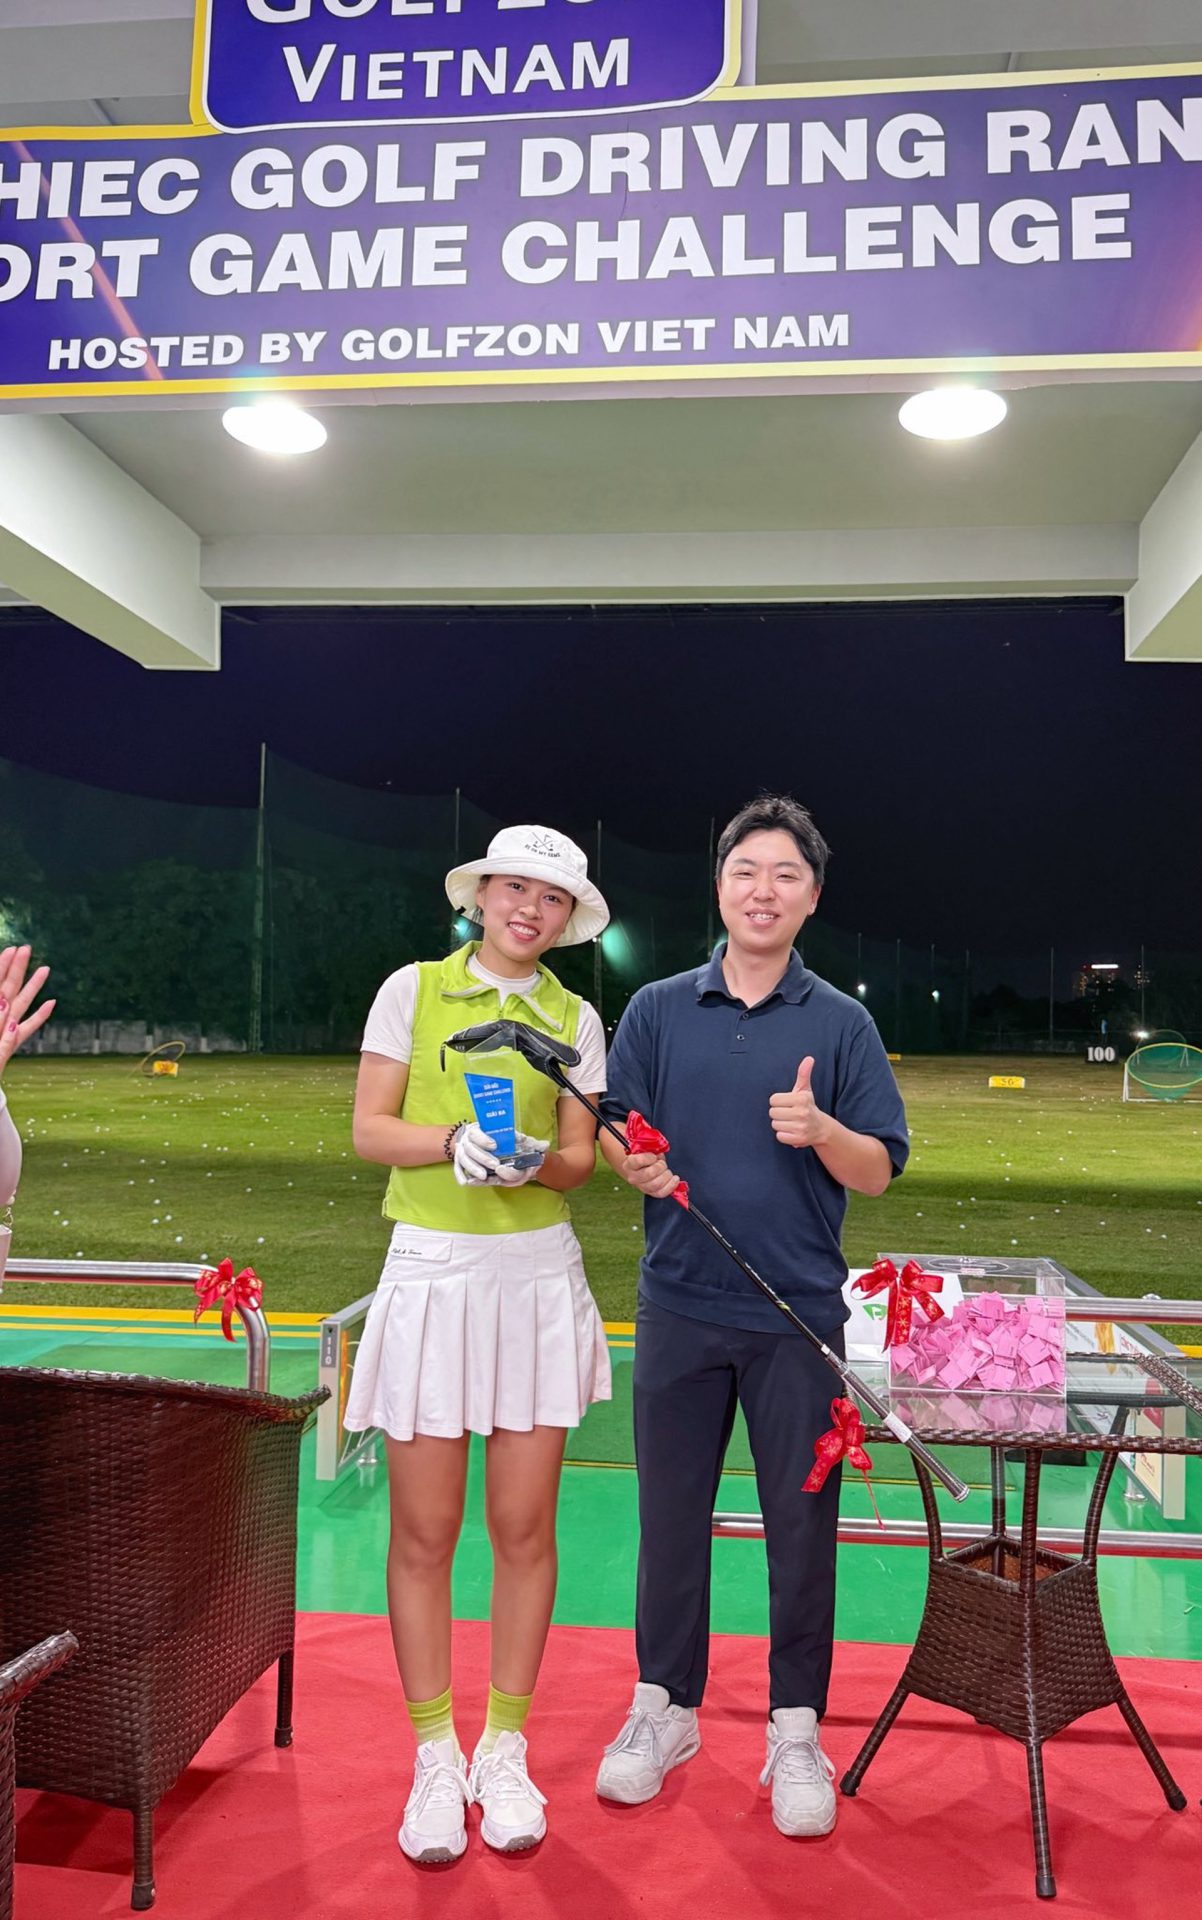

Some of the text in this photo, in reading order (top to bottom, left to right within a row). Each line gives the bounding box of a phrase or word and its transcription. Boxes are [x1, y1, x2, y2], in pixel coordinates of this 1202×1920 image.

[283, 38, 629, 102] VIETNAM
[230, 140, 486, 210] GOLF
[520, 113, 946, 197] DRIVING
[987, 97, 1202, 174] RAN
[189, 225, 468, 296] GAME
[501, 193, 1132, 285] CHALLENGE
[48, 313, 849, 370] HOSTED BY GOLFZON VIET NAM
[1087, 1046, 1116, 1062] 100
